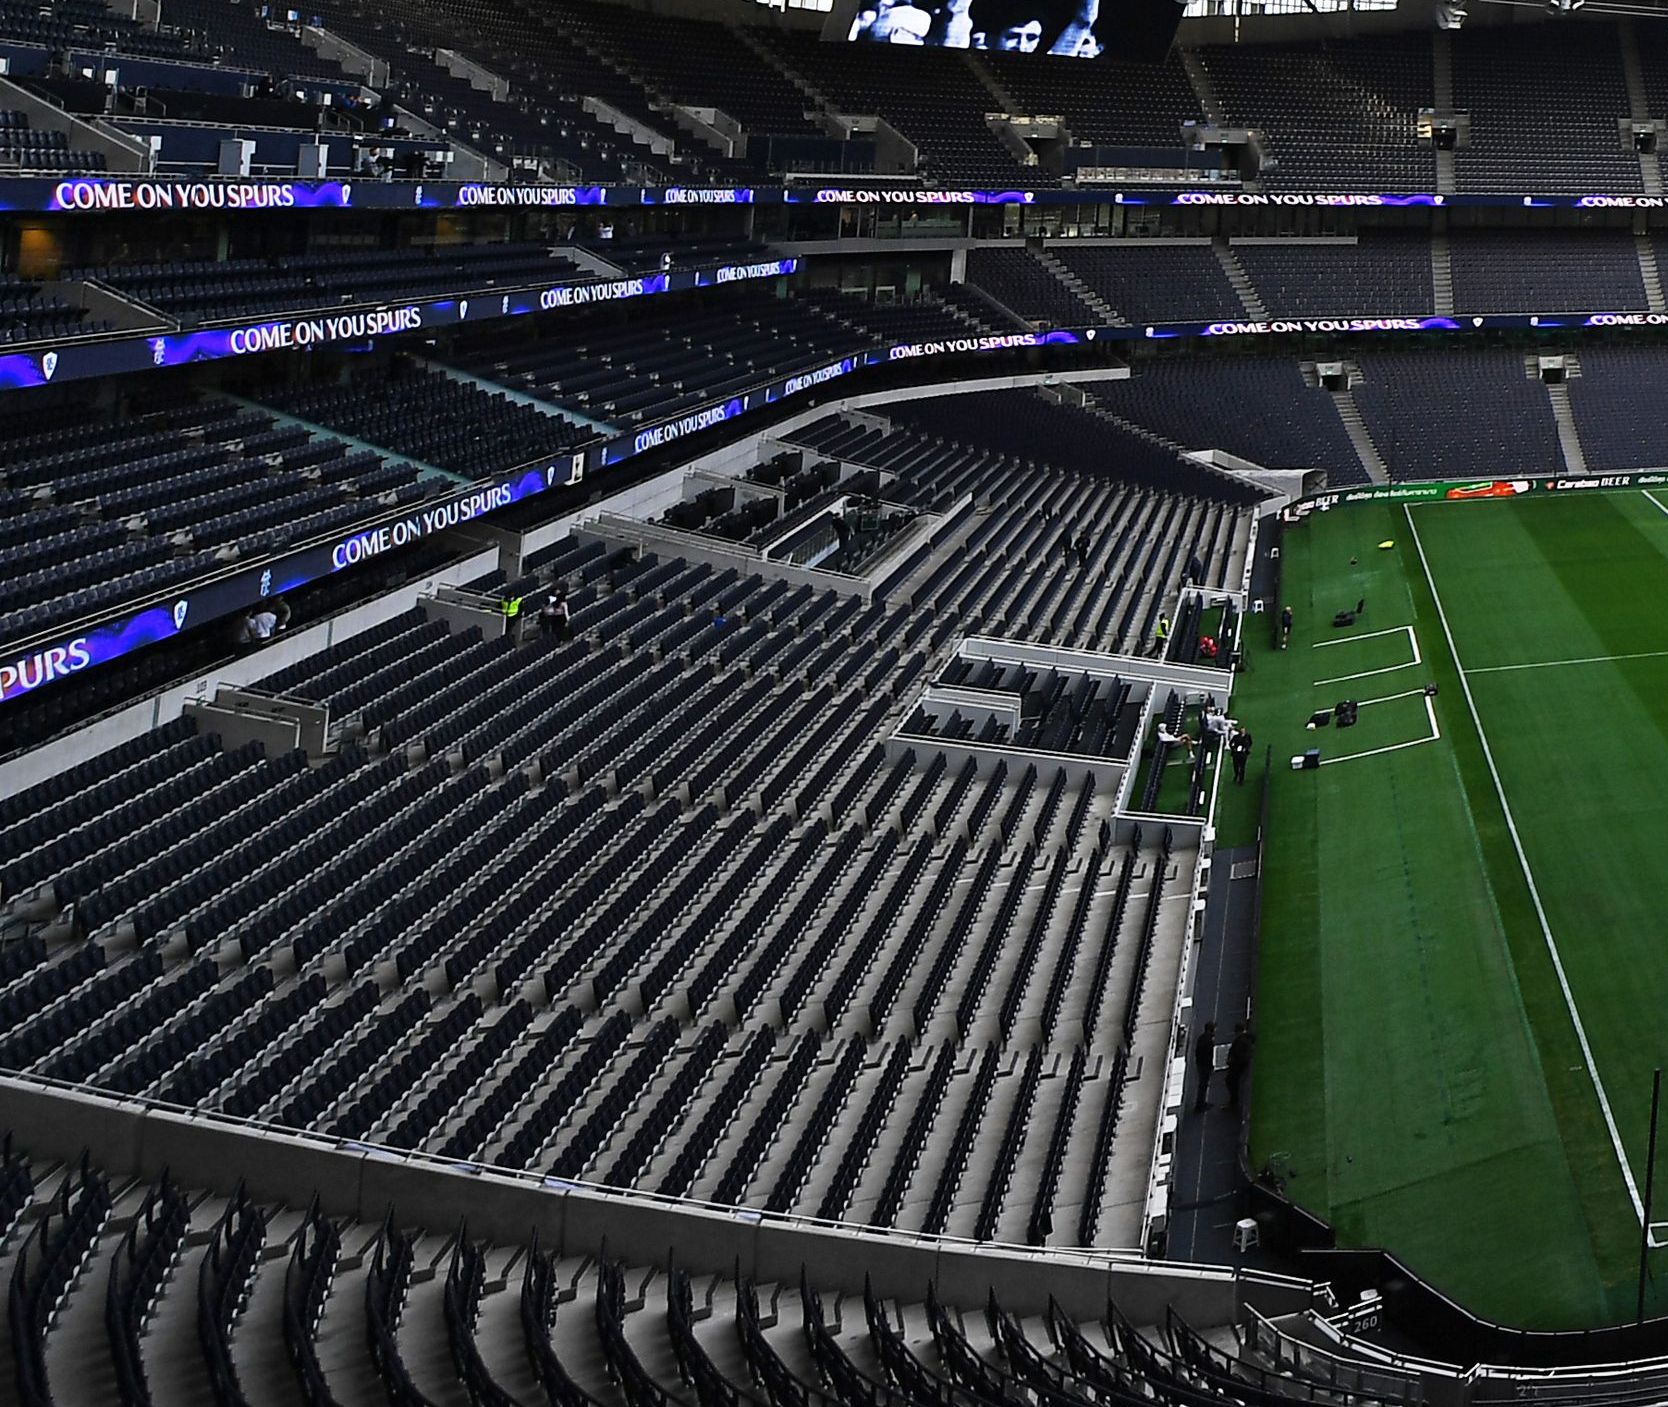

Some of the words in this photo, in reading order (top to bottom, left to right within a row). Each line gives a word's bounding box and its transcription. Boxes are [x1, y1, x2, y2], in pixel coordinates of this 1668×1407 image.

[56, 183, 134, 209] COME
[136, 183, 173, 208] ON
[175, 183, 227, 207] YOU
[227, 183, 294, 207] SPURS
[459, 186, 496, 205] COME
[497, 186, 516, 205] ON
[541, 186, 576, 205] SPURS
[817, 191, 855, 203] COME
[856, 191, 879, 203] ON
[881, 191, 914, 203] YOU
[915, 191, 974, 203] SPURS
[1178, 194, 1237, 205] COME
[1237, 194, 1268, 205] ON
[1269, 194, 1314, 205] YOU
[1315, 194, 1382, 205] SPURS
[1581, 196, 1635, 208] COME
[1636, 196, 1664, 208] ON
[540, 286, 574, 309] COME
[574, 284, 589, 304] ON
[590, 282, 613, 302] YOU
[613, 279, 643, 298] SPURS
[1209, 322, 1271, 333] COME
[1271, 321, 1302, 333] ON
[1304, 320, 1348, 332] YOU
[1348, 319, 1420, 331] SPURS
[1590, 315, 1646, 325] COME
[230, 322, 294, 354] COME
[296, 318, 325, 344] ON
[326, 316, 364, 339] YOU
[366, 307, 421, 335] SPURS
[890, 346, 924, 360] COME
[925, 343, 945, 355] ON
[946, 338, 978, 352] YOU
[980, 334, 1035, 352] SPURS
[635, 428, 664, 453] COME
[664, 422, 678, 441] ON
[698, 405, 725, 429] SPURS
[1600, 476, 1631, 487] BEER
[332, 527, 391, 569] COME
[393, 516, 421, 545] ON
[423, 503, 459, 533] YOU
[460, 483, 511, 521] SPURS
[1354, 1315, 1378, 1333] 260
